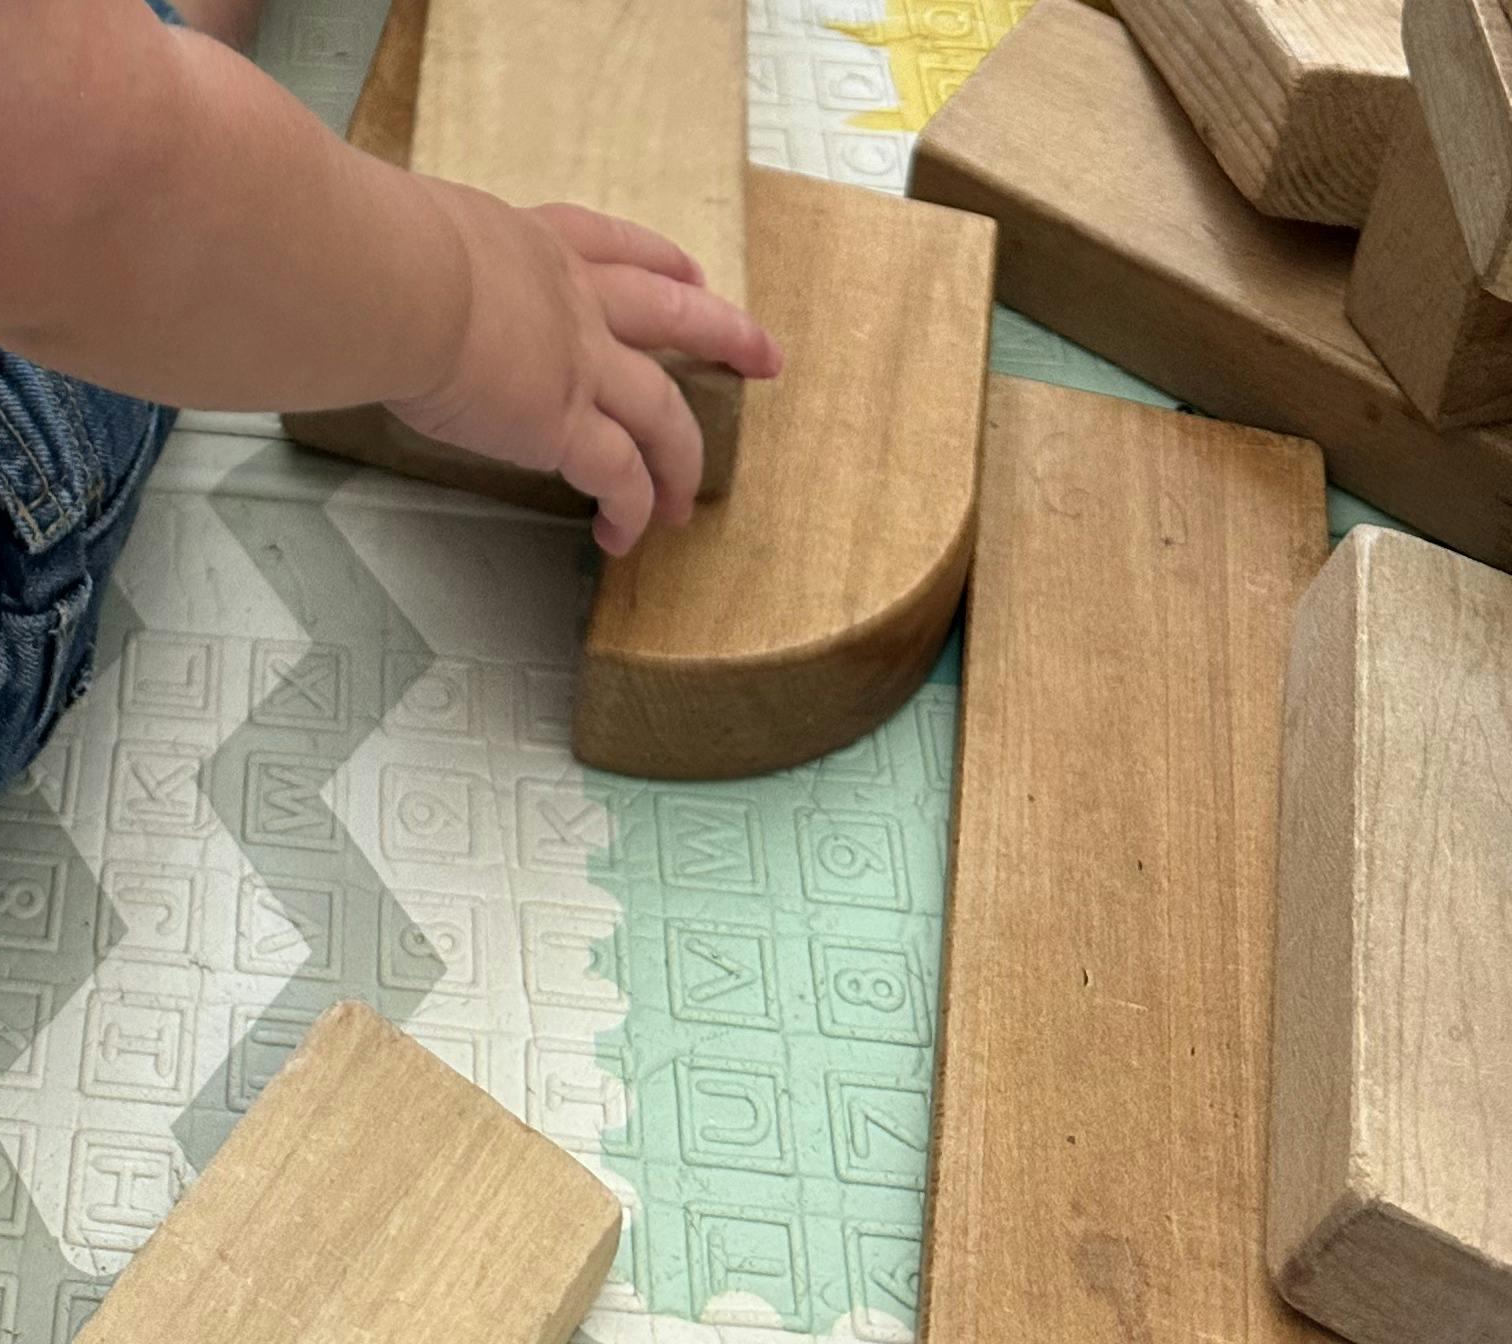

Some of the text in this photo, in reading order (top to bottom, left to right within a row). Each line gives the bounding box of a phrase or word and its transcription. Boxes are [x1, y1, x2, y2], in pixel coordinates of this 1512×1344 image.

[265, 658, 332, 712] X
[128, 760, 199, 818] K
[260, 764, 327, 833] W
[676, 808, 750, 877] W
[816, 832, 887, 880] 9
[116, 887, 182, 936] J
[254, 891, 325, 956] V
[399, 920, 467, 962] 8
[683, 935, 758, 1002] V
[833, 968, 906, 1013] 8
[101, 1021, 172, 1079] I
[695, 1077, 772, 1146] U
[848, 1096, 929, 1160] 7
[89, 1154, 164, 1230] H
[705, 1226, 786, 1294] T
